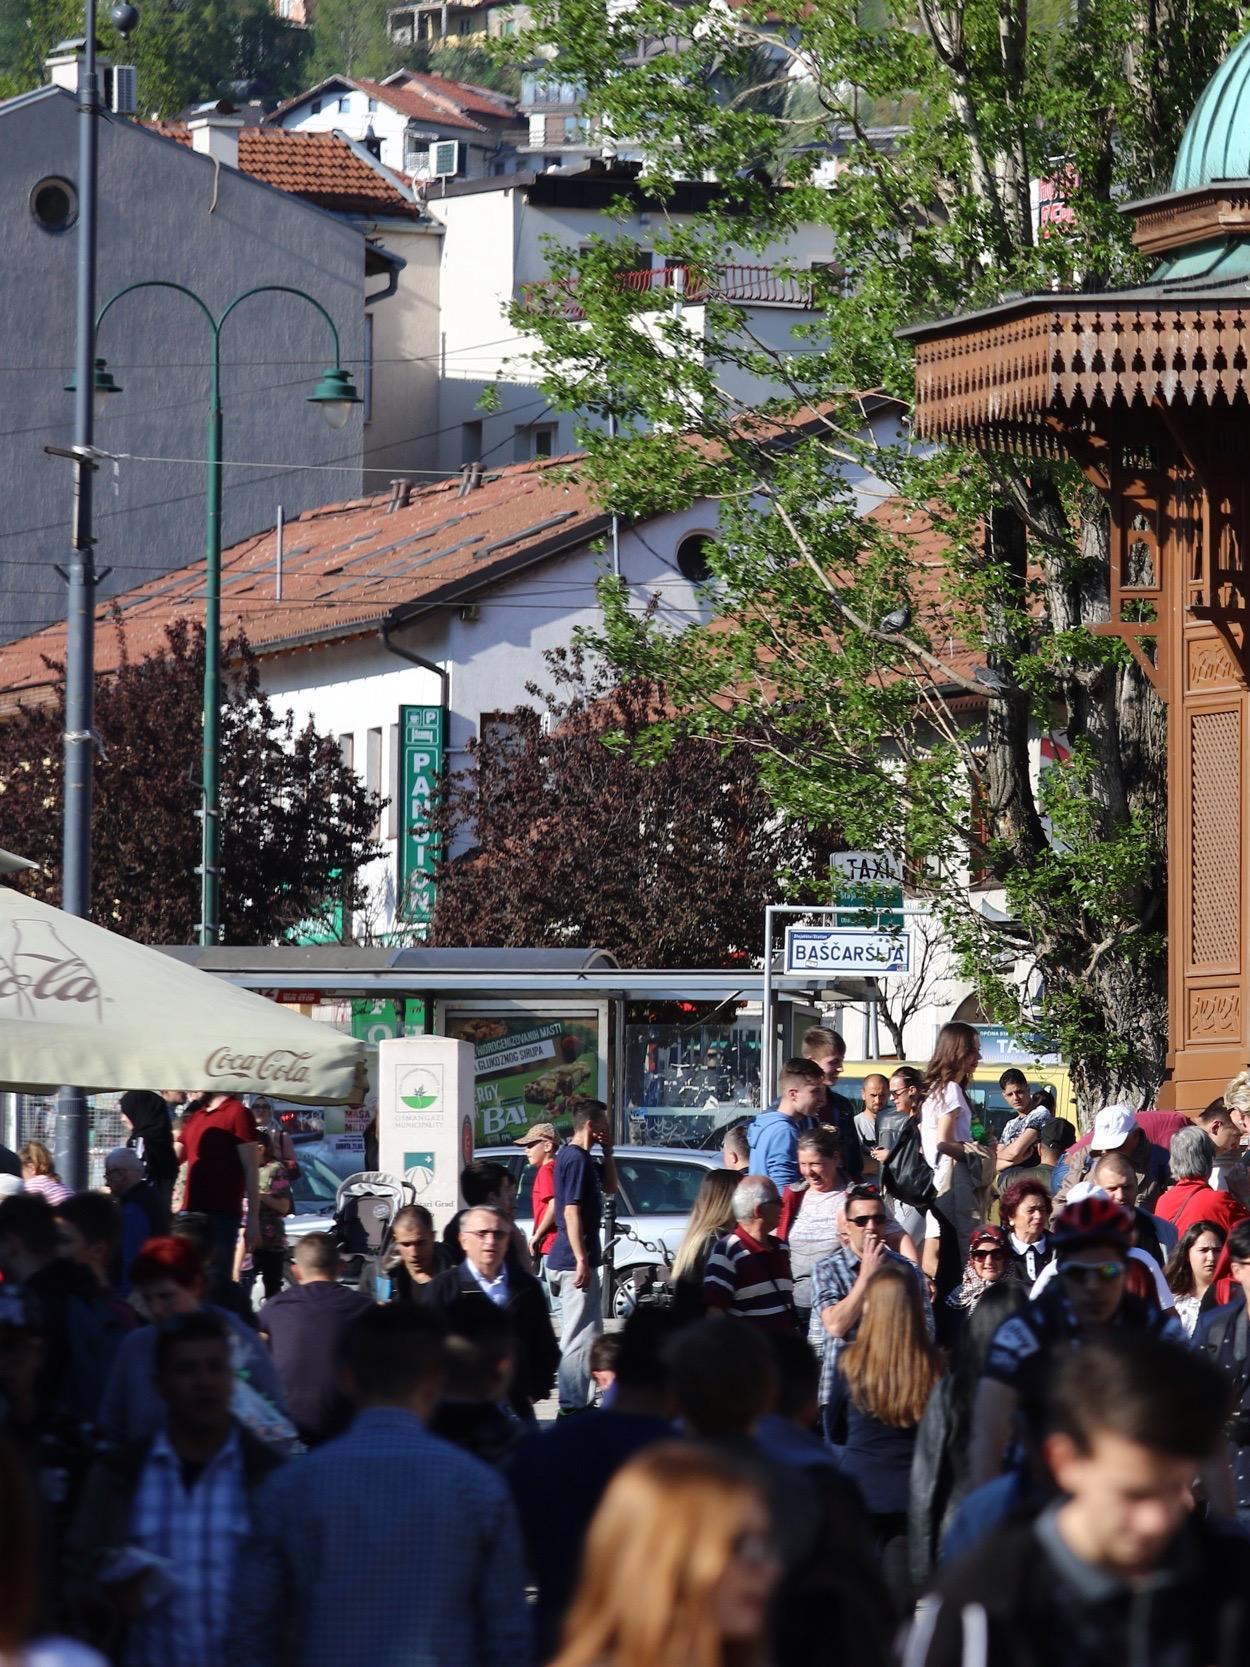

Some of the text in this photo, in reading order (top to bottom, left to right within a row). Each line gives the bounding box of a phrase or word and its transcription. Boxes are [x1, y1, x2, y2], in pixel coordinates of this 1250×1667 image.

[411, 752, 431, 912] PANSION
[847, 858, 890, 879] TAXI
[795, 941, 904, 962] BAŠČARŠIJA
[204, 1046, 315, 1083] Coca-Cola
[480, 1104, 528, 1136] BA!
[435, 1200, 454, 1208] Grad
